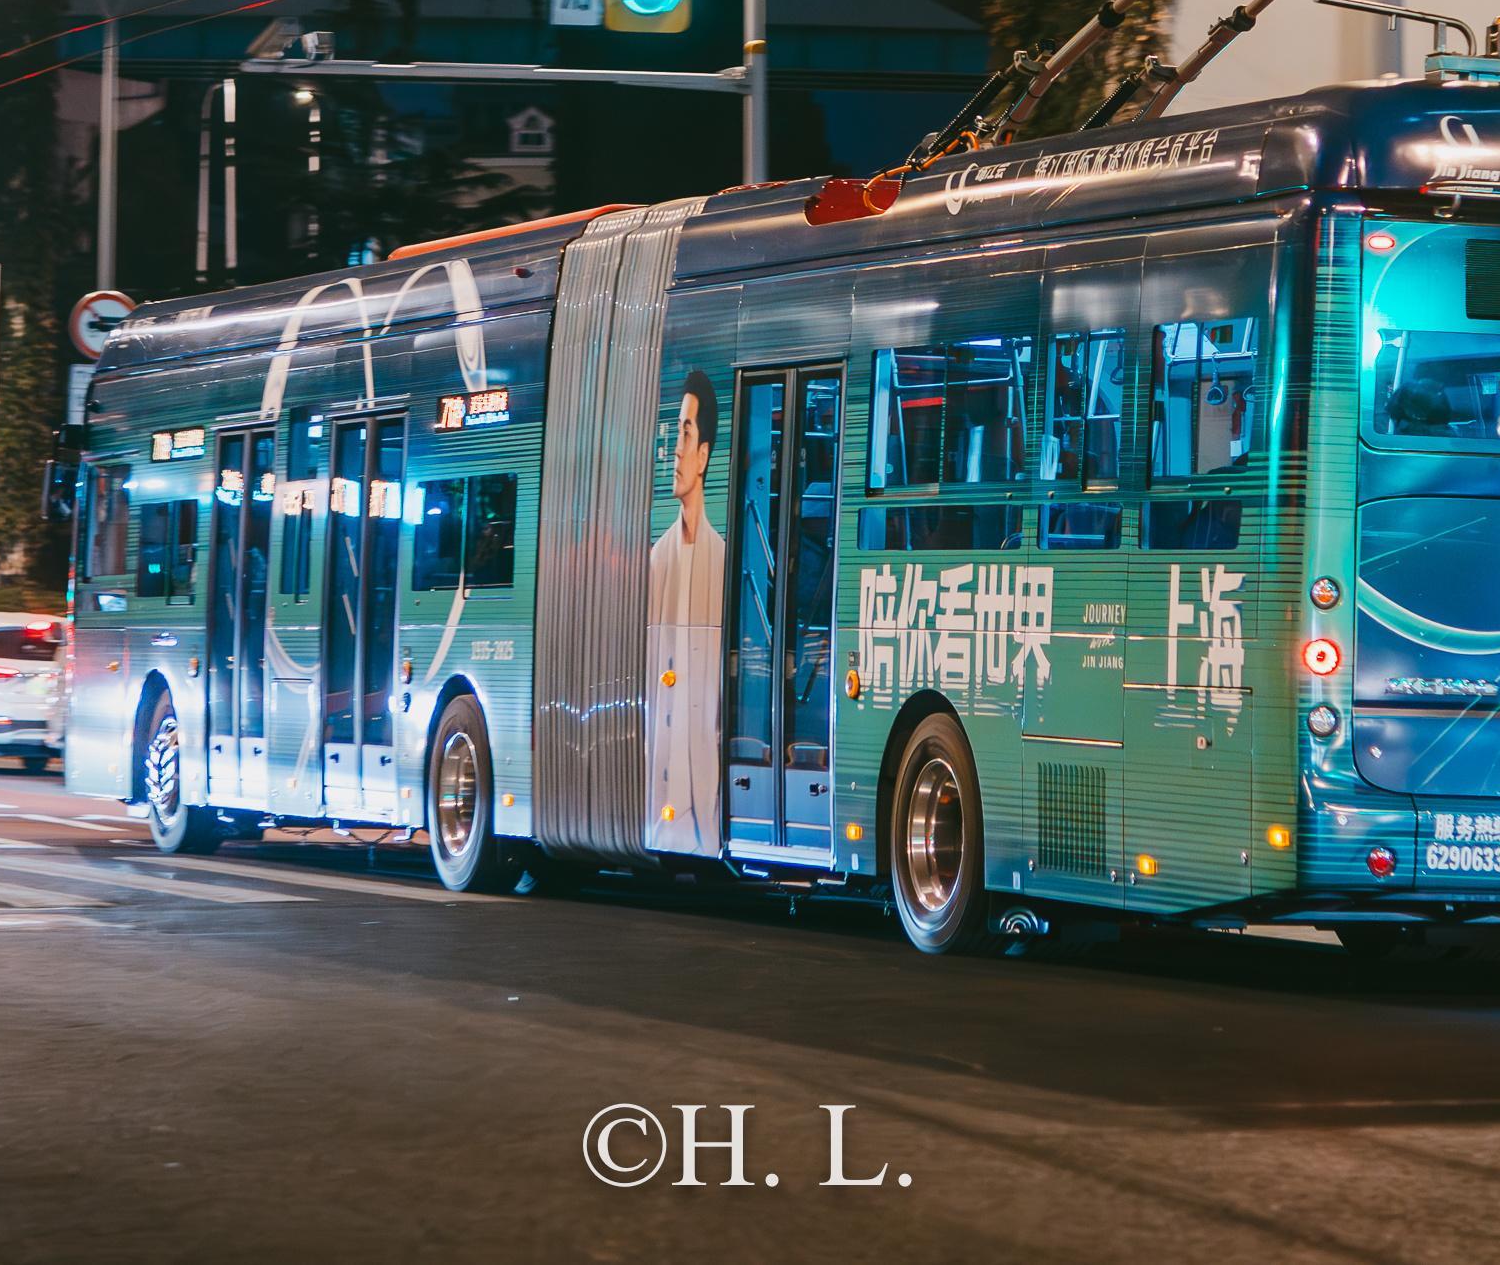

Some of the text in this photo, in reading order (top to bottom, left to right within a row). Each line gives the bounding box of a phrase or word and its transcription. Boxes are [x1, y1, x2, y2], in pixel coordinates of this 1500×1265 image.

[1083, 604, 1127, 624] JOURNEY
[858, 563, 1248, 726] 陪你看世界 上海
[1082, 655, 1125, 670] JIN JIANG
